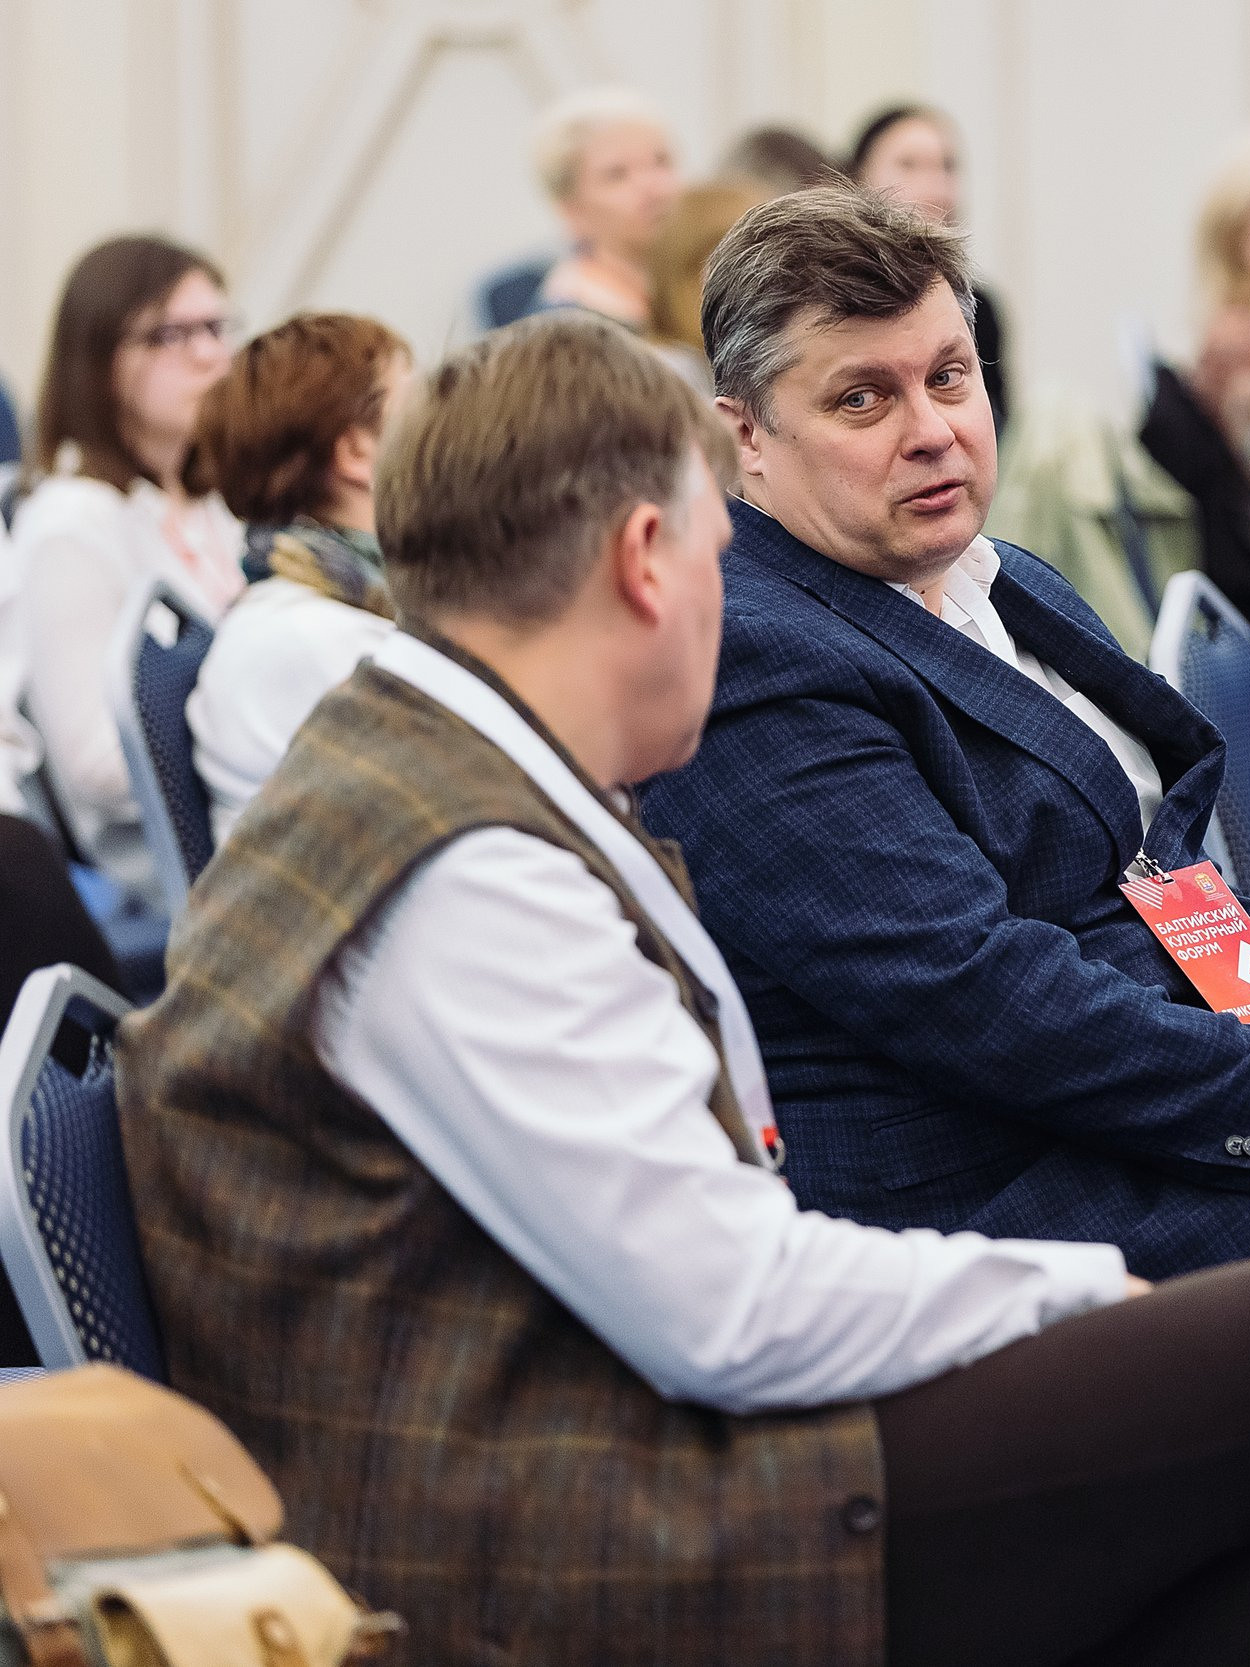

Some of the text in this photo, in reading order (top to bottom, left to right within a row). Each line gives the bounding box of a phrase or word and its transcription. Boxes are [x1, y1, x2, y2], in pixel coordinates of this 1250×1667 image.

[1155, 903, 1240, 935] БАЛТИЙСКИЙ
[1165, 916, 1248, 949] КУЛЬТУРНЫЙ
[1176, 941, 1223, 962] ФОРУМ
